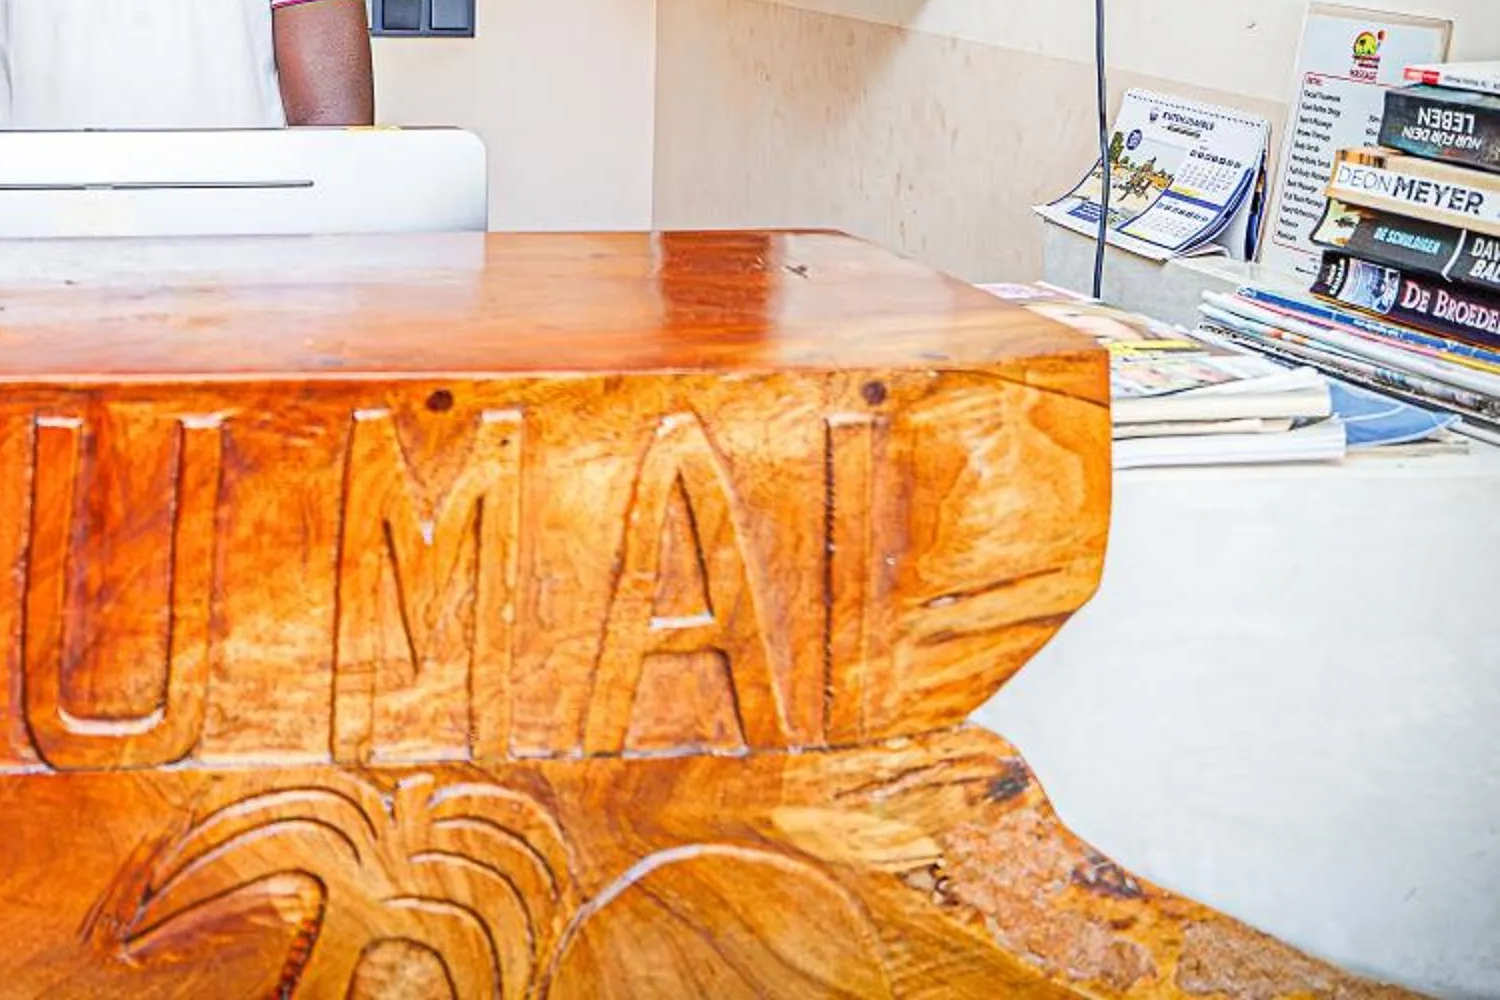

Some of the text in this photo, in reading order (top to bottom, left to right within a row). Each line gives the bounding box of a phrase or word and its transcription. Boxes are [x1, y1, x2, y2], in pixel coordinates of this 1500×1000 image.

[1417, 107, 1475, 133] LEBEN
[1338, 165, 1484, 214] DEON MEYER
[1401, 280, 1431, 313] DE
